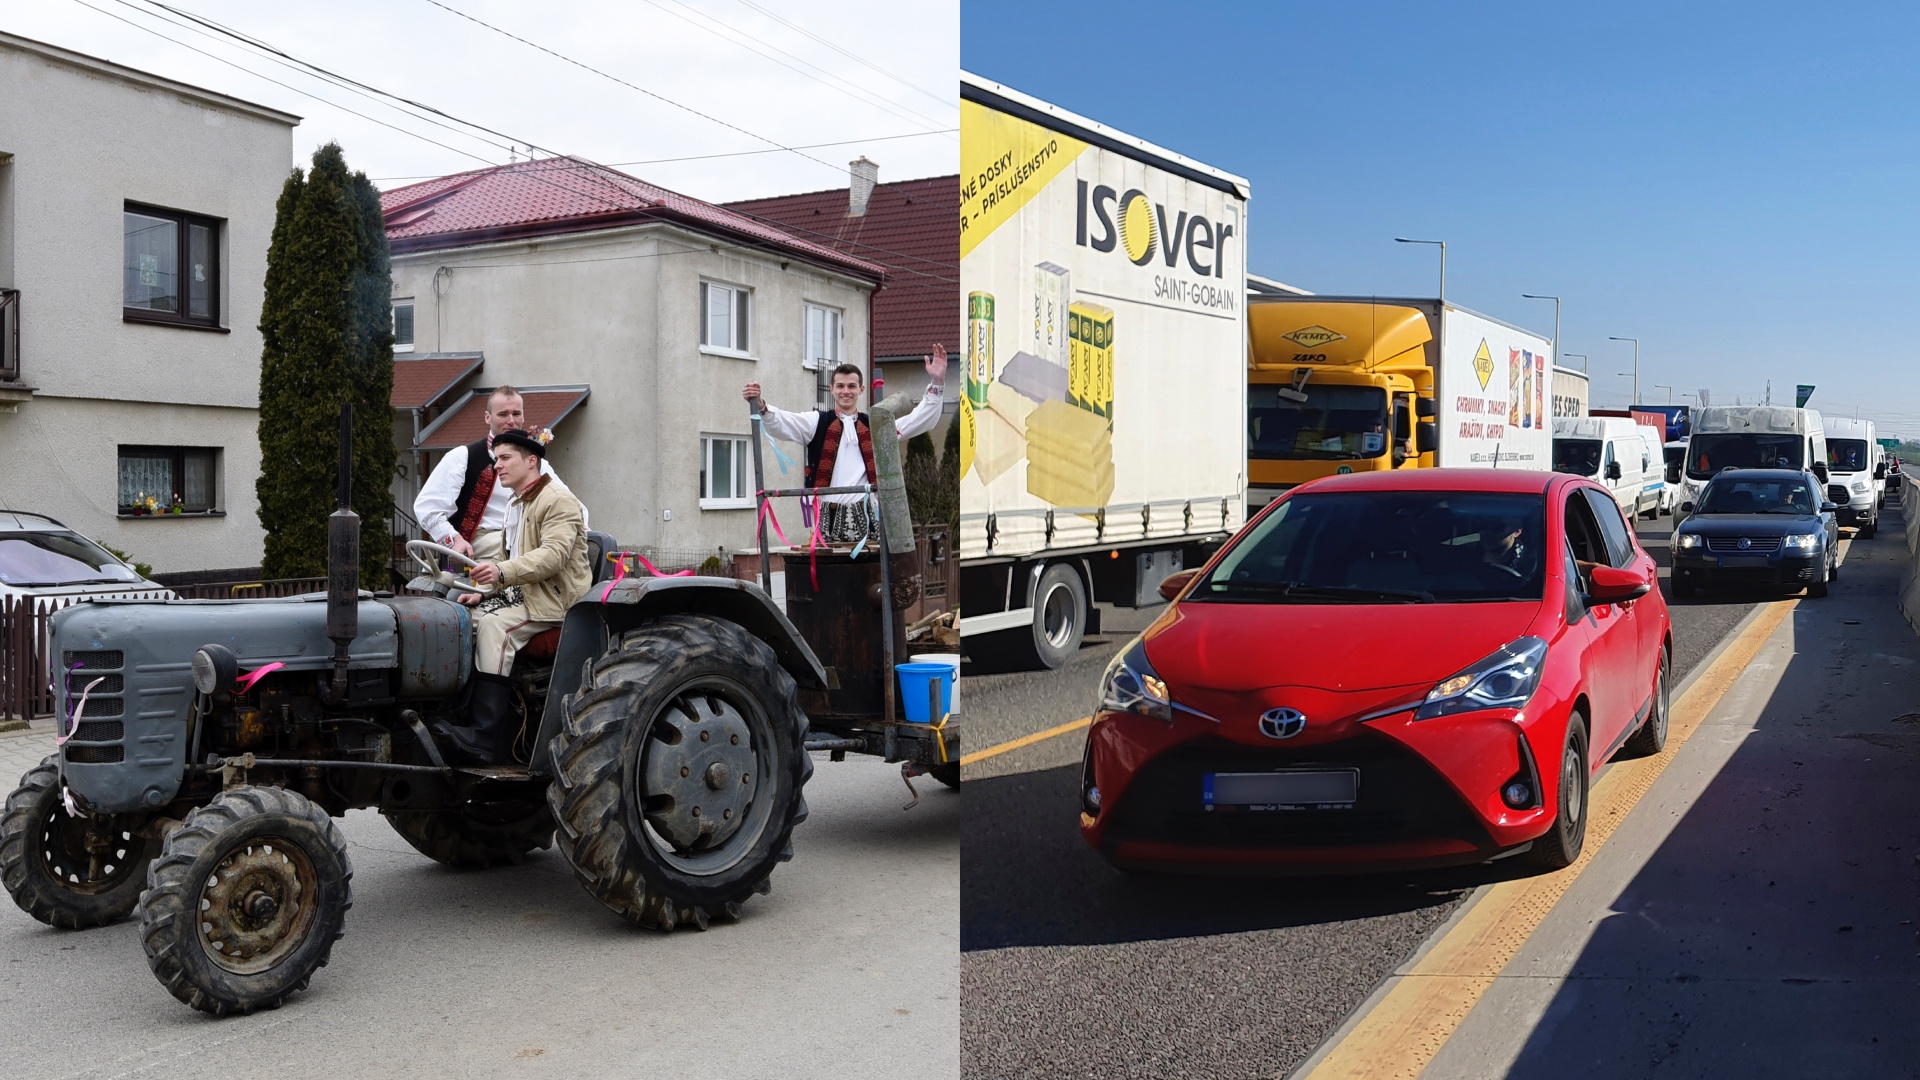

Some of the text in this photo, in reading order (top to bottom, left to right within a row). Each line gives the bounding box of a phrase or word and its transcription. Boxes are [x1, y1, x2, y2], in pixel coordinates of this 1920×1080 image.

[979, 150, 1012, 190] DOSKY
[982, 139, 1057, 215] PRÍSLUŠENSTVO
[1154, 275, 1234, 311] SAINT-GOBAIN
[1292, 332, 1335, 341] NAMEX
[1291, 353, 1327, 362] ZAKO
[1456, 396, 1507, 417] CHRUMKY, SNACKY
[1563, 396, 1580, 417] SPED
